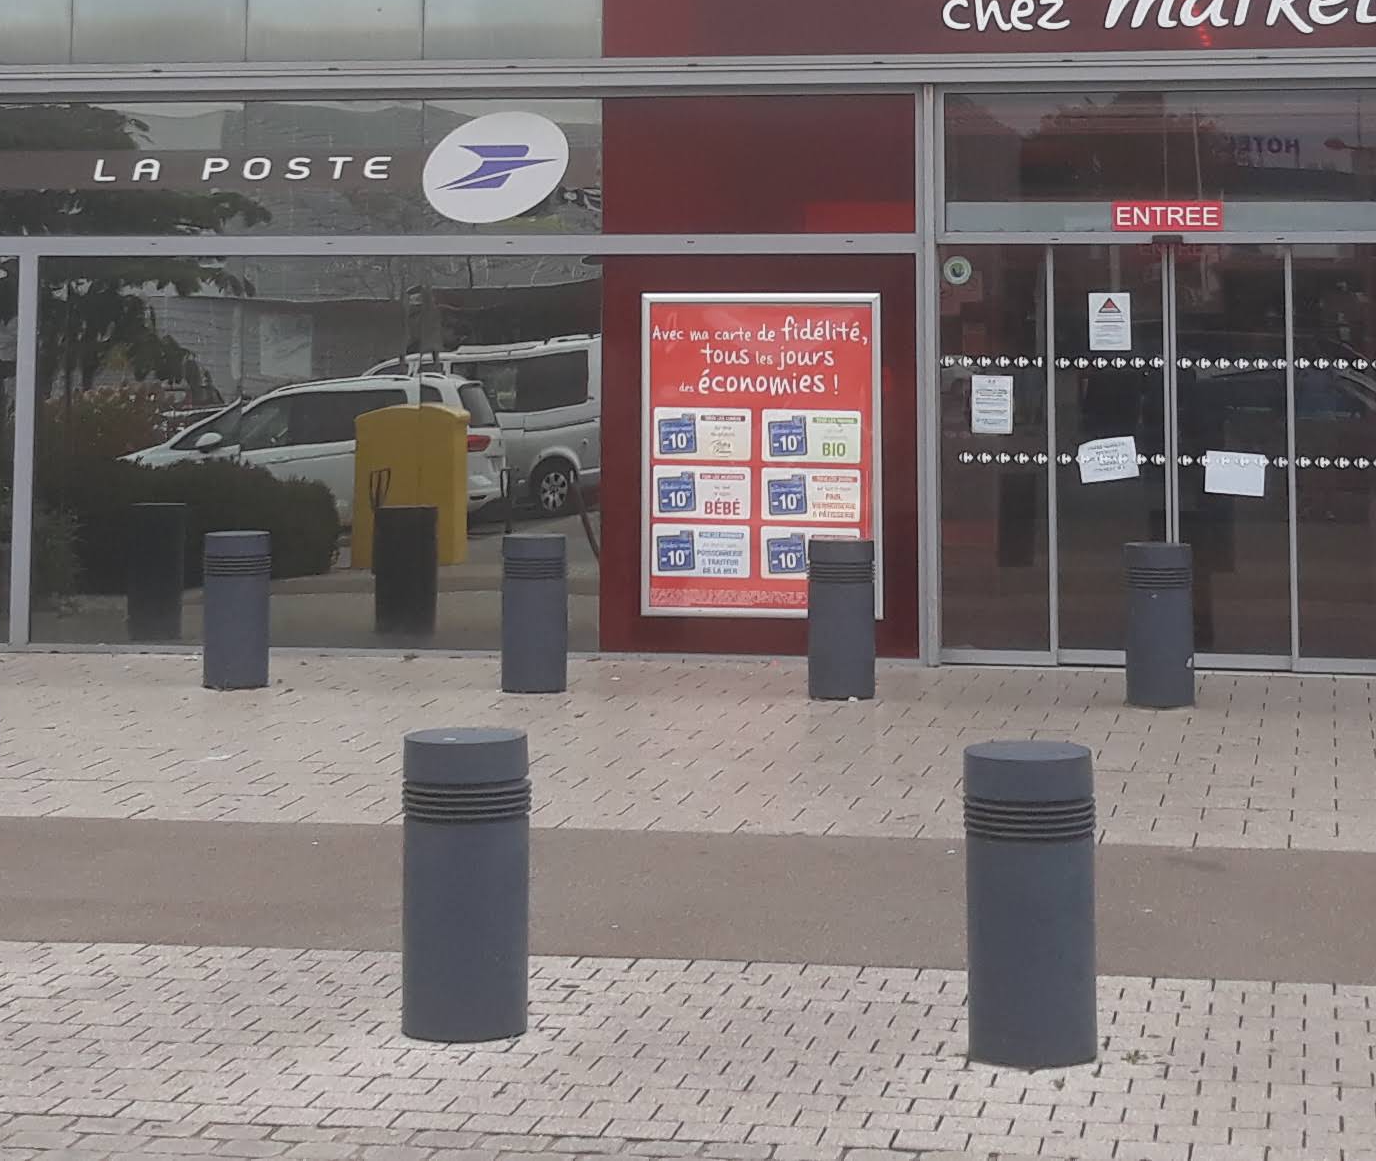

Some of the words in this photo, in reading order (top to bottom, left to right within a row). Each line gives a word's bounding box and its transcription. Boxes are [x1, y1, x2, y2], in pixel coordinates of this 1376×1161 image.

[93, 158, 161, 182] LA
[201, 156, 393, 181] POSTE
[1116, 206, 1219, 226] ENTREE
[652, 325, 684, 341] Avec
[690, 329, 709, 341] ma
[714, 327, 752, 341] carte
[757, 324, 775, 341] de
[781, 315, 868, 345] fidélité,
[700, 343, 750, 365] tous
[755, 351, 773, 365] les
[777, 346, 835, 371] jours
[679, 382, 694, 393] des
[698, 369, 826, 396] économies
[822, 442, 846, 457] BIO
[704, 497, 741, 516] BÉBÉ
